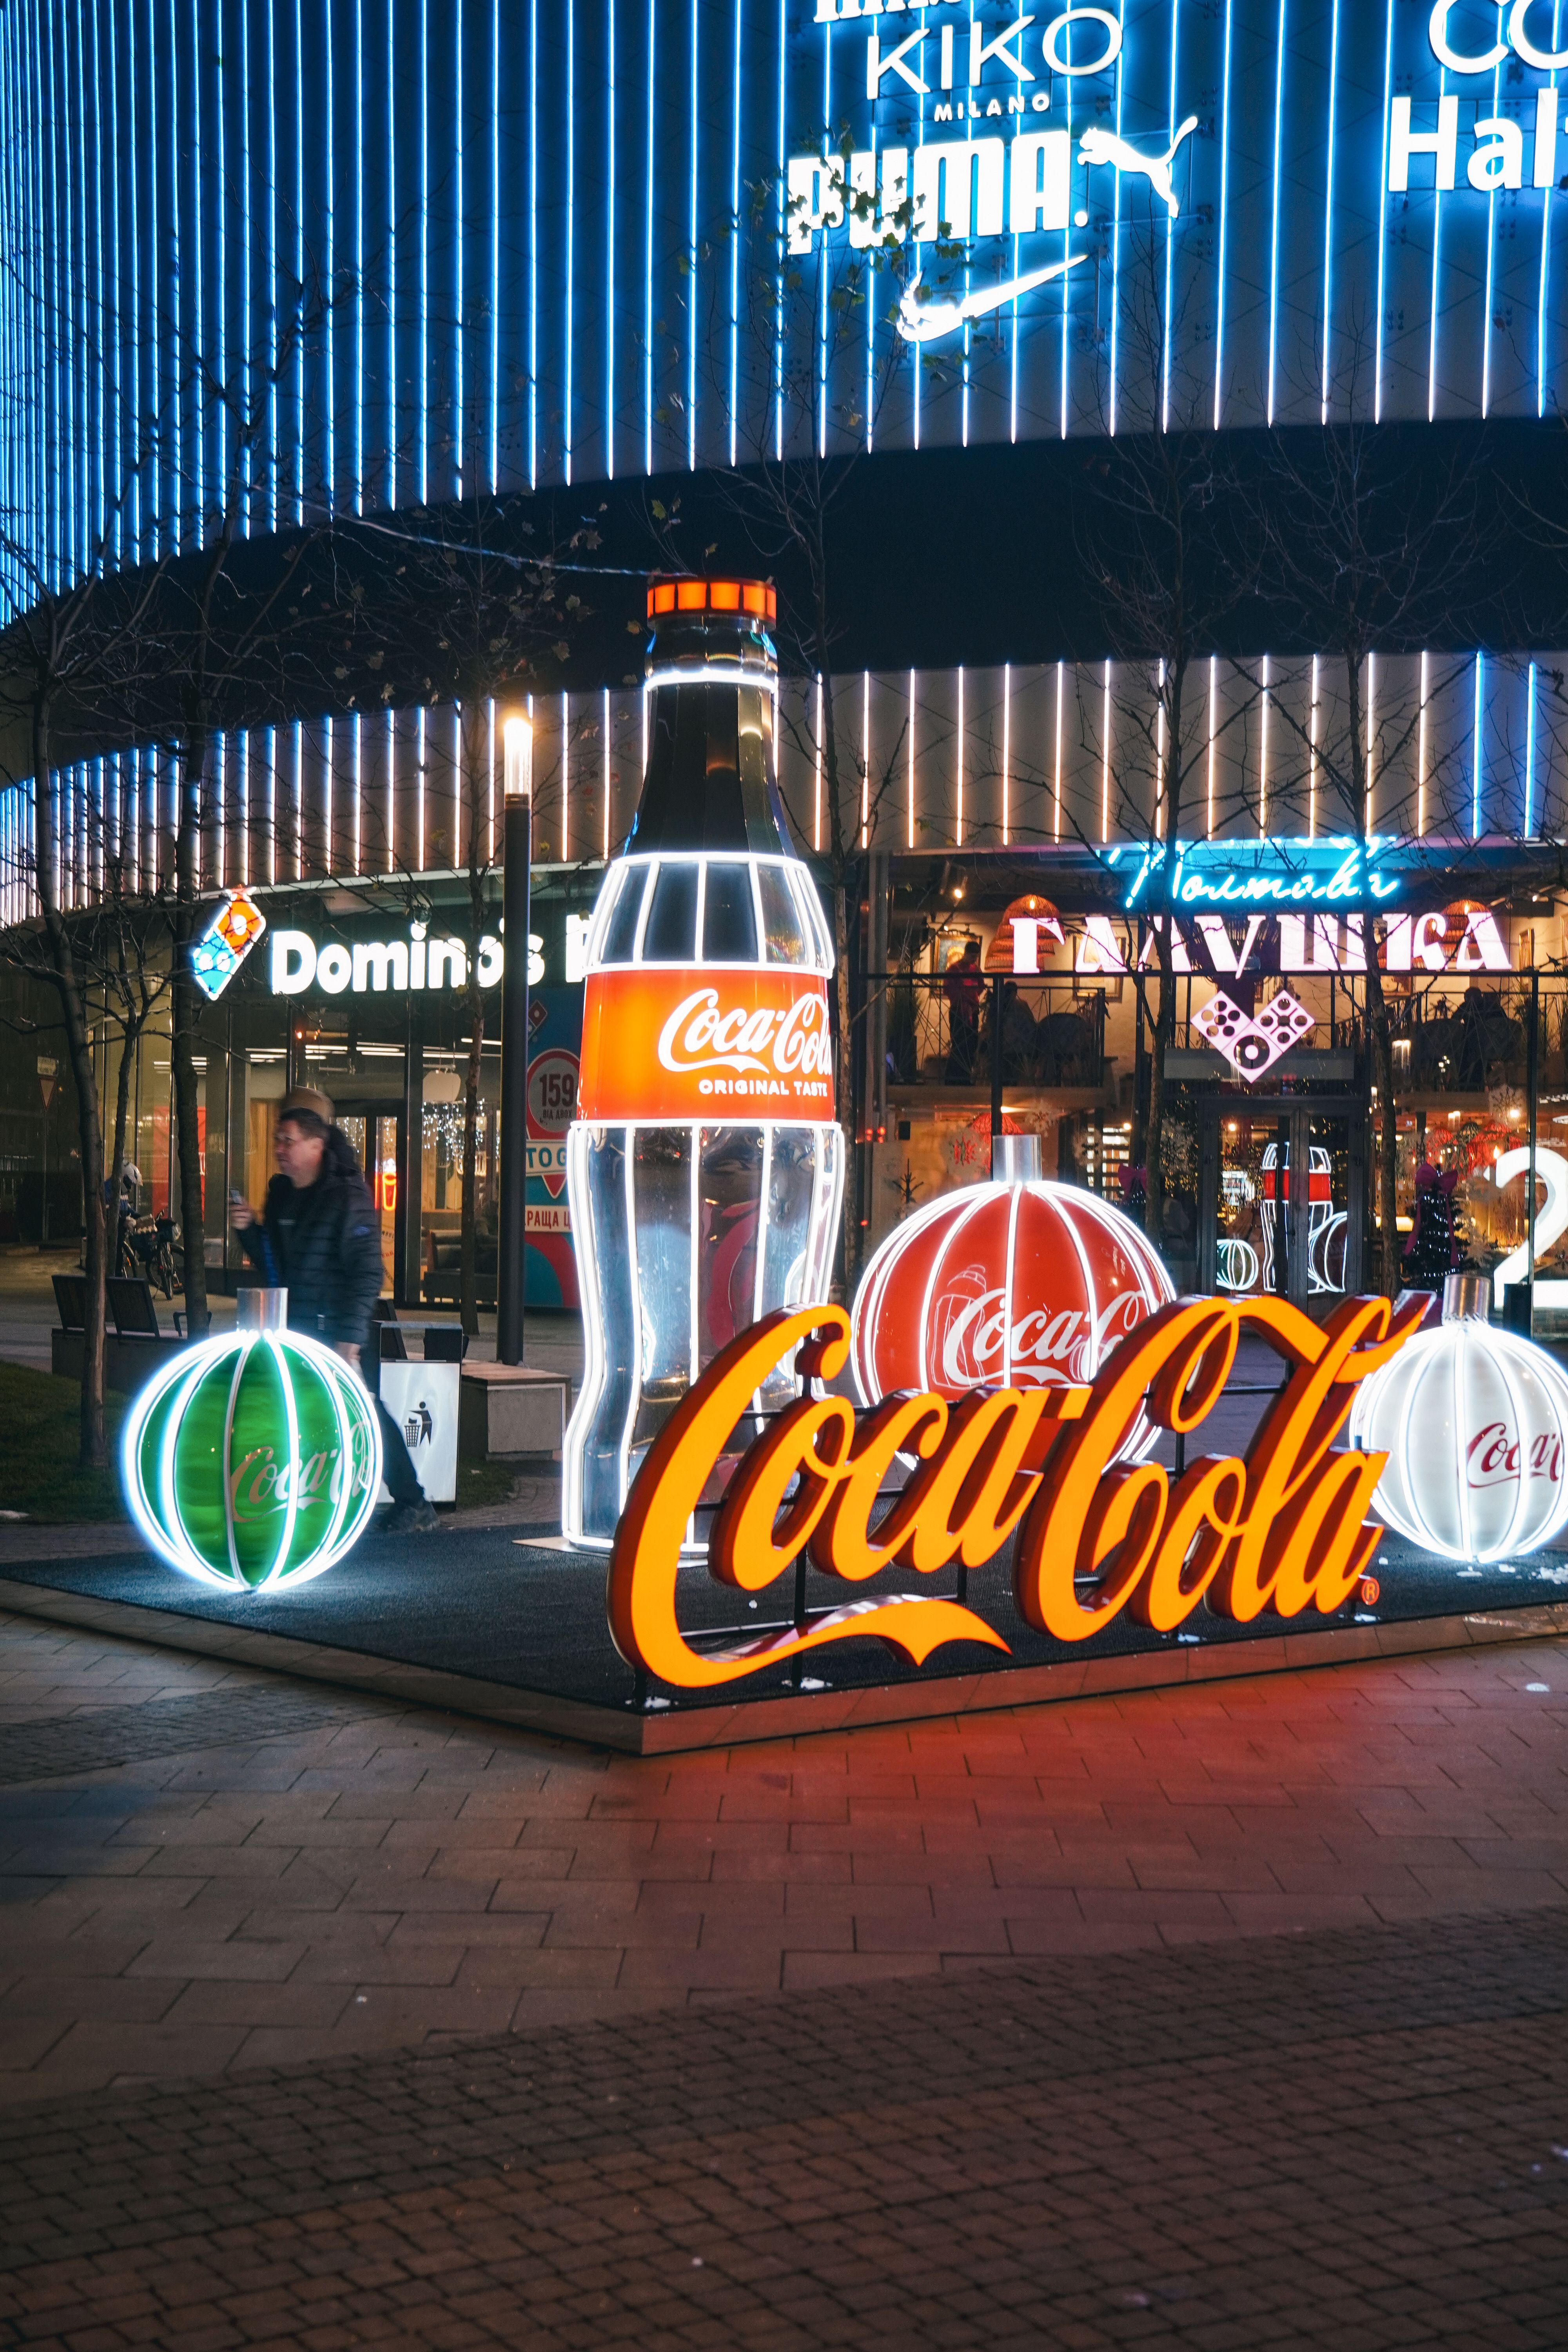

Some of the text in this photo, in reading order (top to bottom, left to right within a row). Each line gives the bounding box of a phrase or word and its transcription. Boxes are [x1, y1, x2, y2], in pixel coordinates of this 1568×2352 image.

[866, 7, 1123, 100] KIKO
[934, 93, 1050, 122] MILANO
[1388, 87, 1568, 192] Hal
[539, 1073, 574, 1107] 159
[699, 1079, 828, 1097] ORIGINAL TASTE
[526, 1147, 552, 1168] TO
[525, 1210, 559, 1230] РАЩА
[610, 1290, 1436, 1688] Coca-Cola
